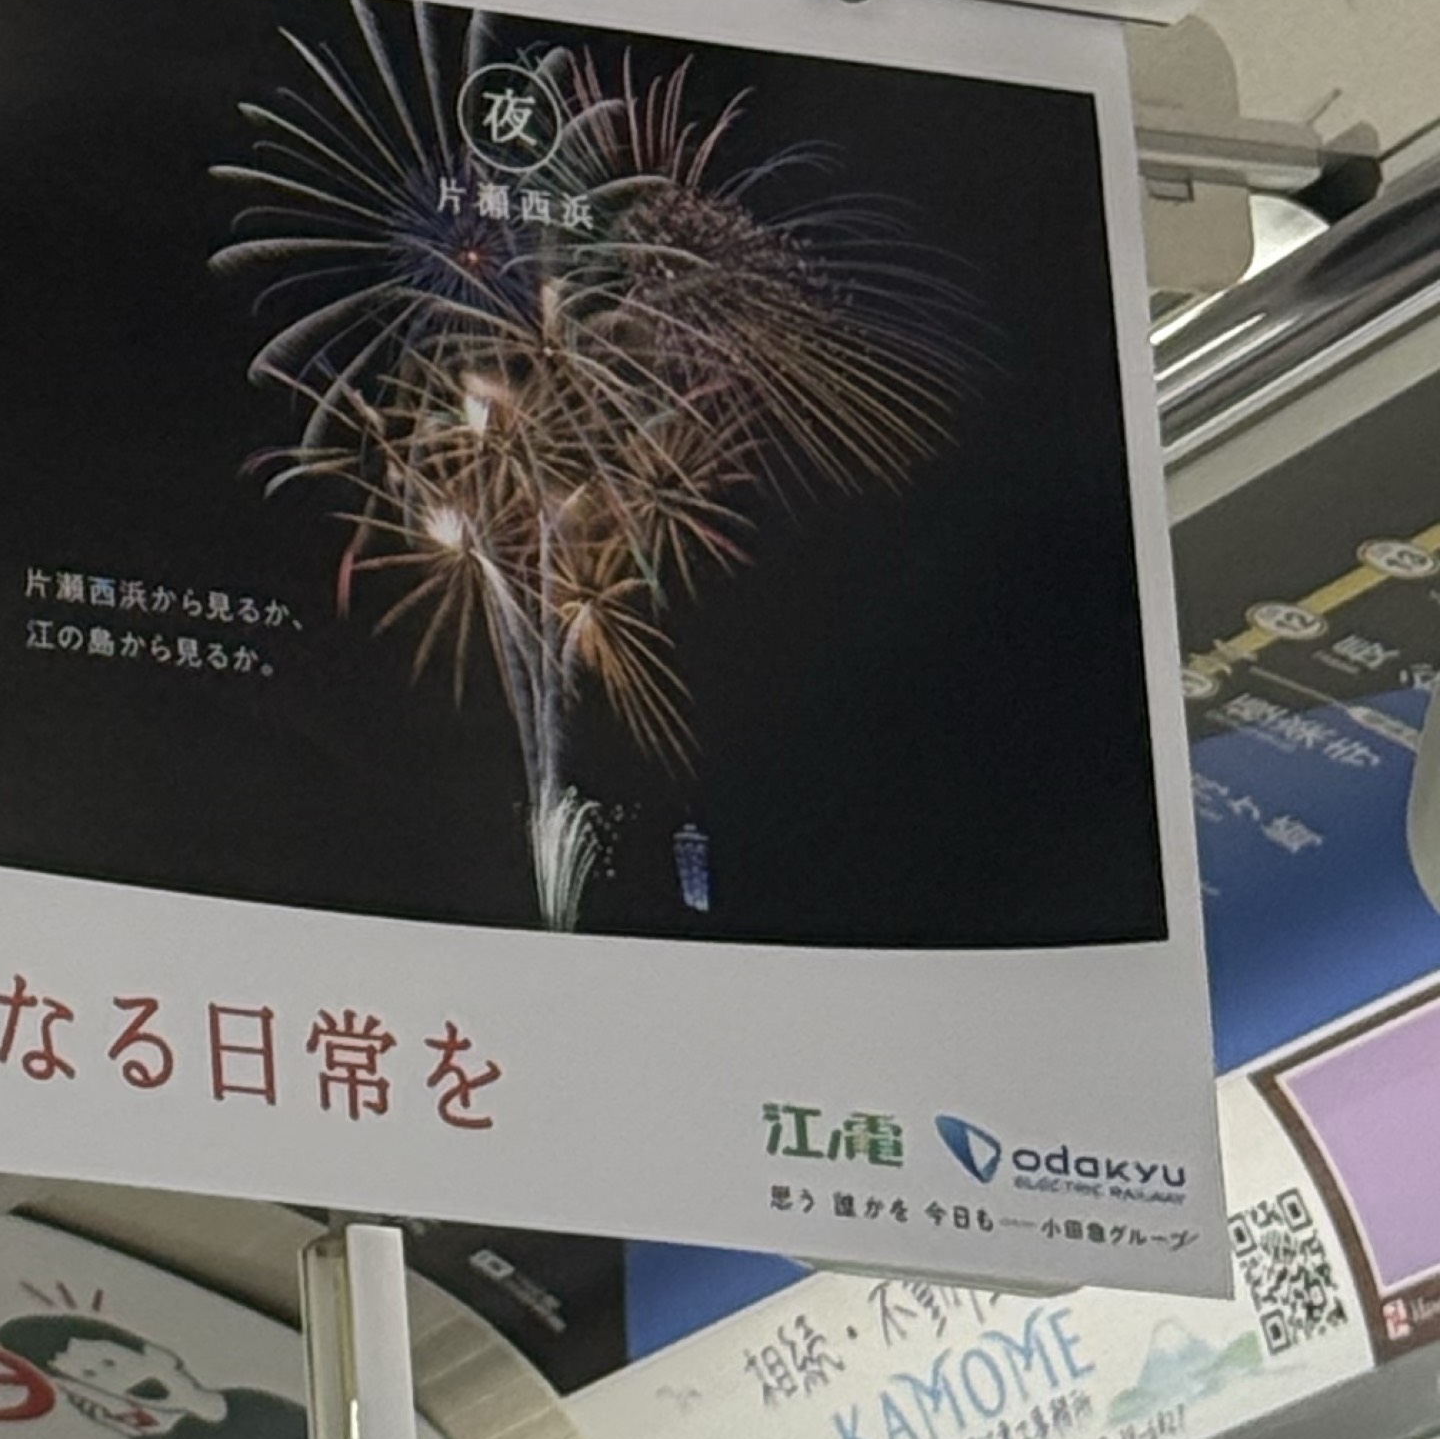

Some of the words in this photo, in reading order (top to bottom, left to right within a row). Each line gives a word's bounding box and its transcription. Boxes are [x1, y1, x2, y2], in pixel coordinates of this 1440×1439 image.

[482, 88, 537, 146] 夜
[436, 176, 593, 231] 片瀬西浜
[25, 567, 303, 631] 片瀬西浜から見るか、
[26, 619, 274, 677] 江の島から見るか。
[1012, 1144, 1186, 1187] odakyu
